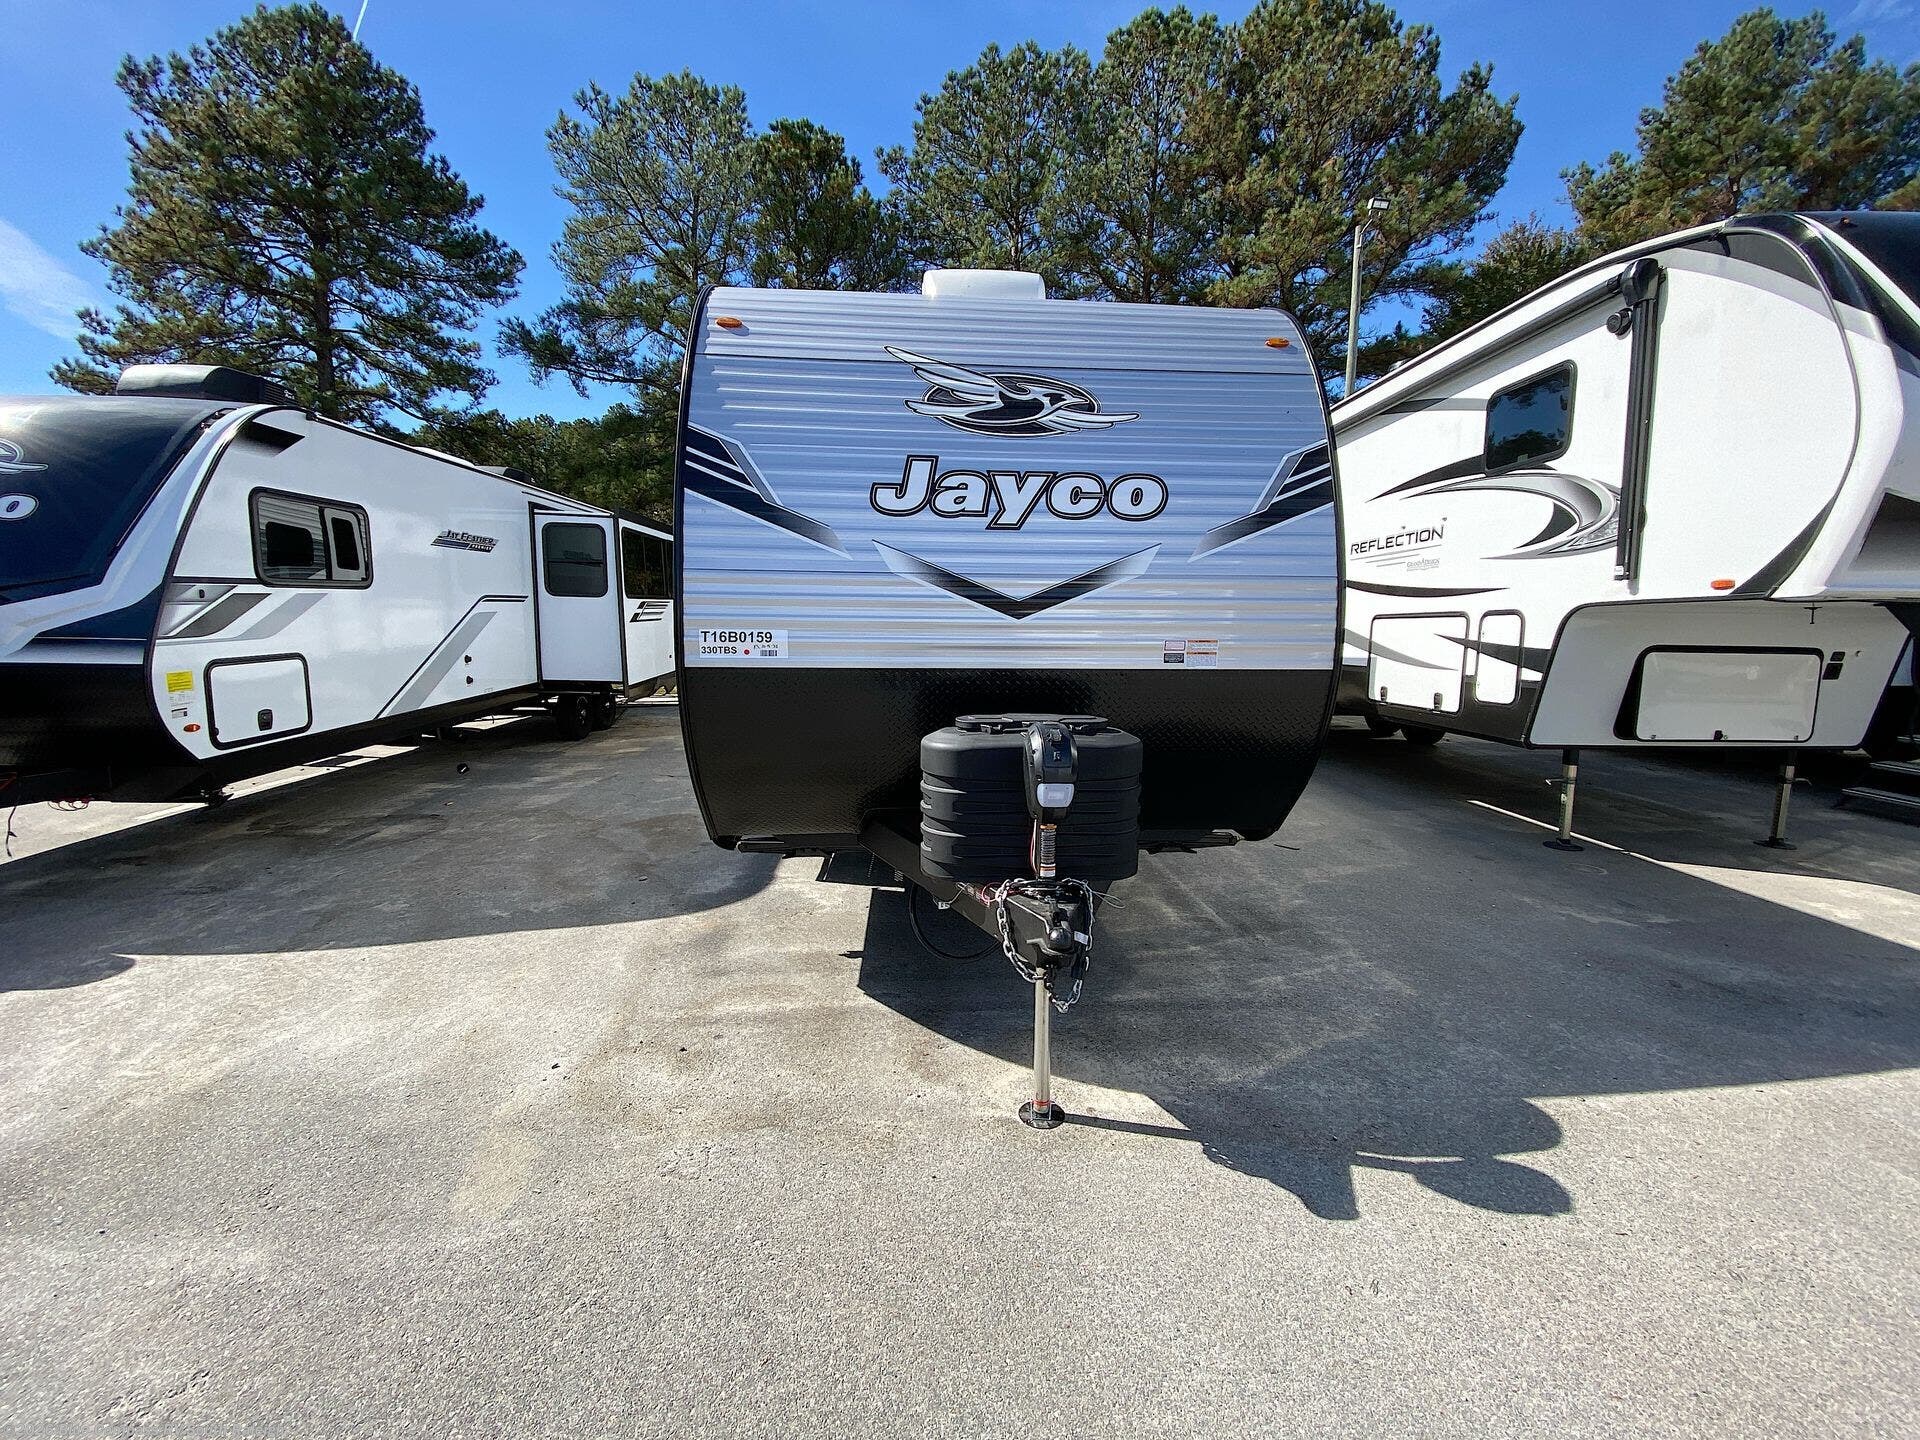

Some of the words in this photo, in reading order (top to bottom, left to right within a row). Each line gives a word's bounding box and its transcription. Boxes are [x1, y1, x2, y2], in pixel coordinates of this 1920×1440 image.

[870, 455, 1169, 530] Jayco
[1350, 524, 1444, 555] REFLECTION
[701, 631, 773, 643] T16B0159
[701, 646, 737, 654] 330TBS
